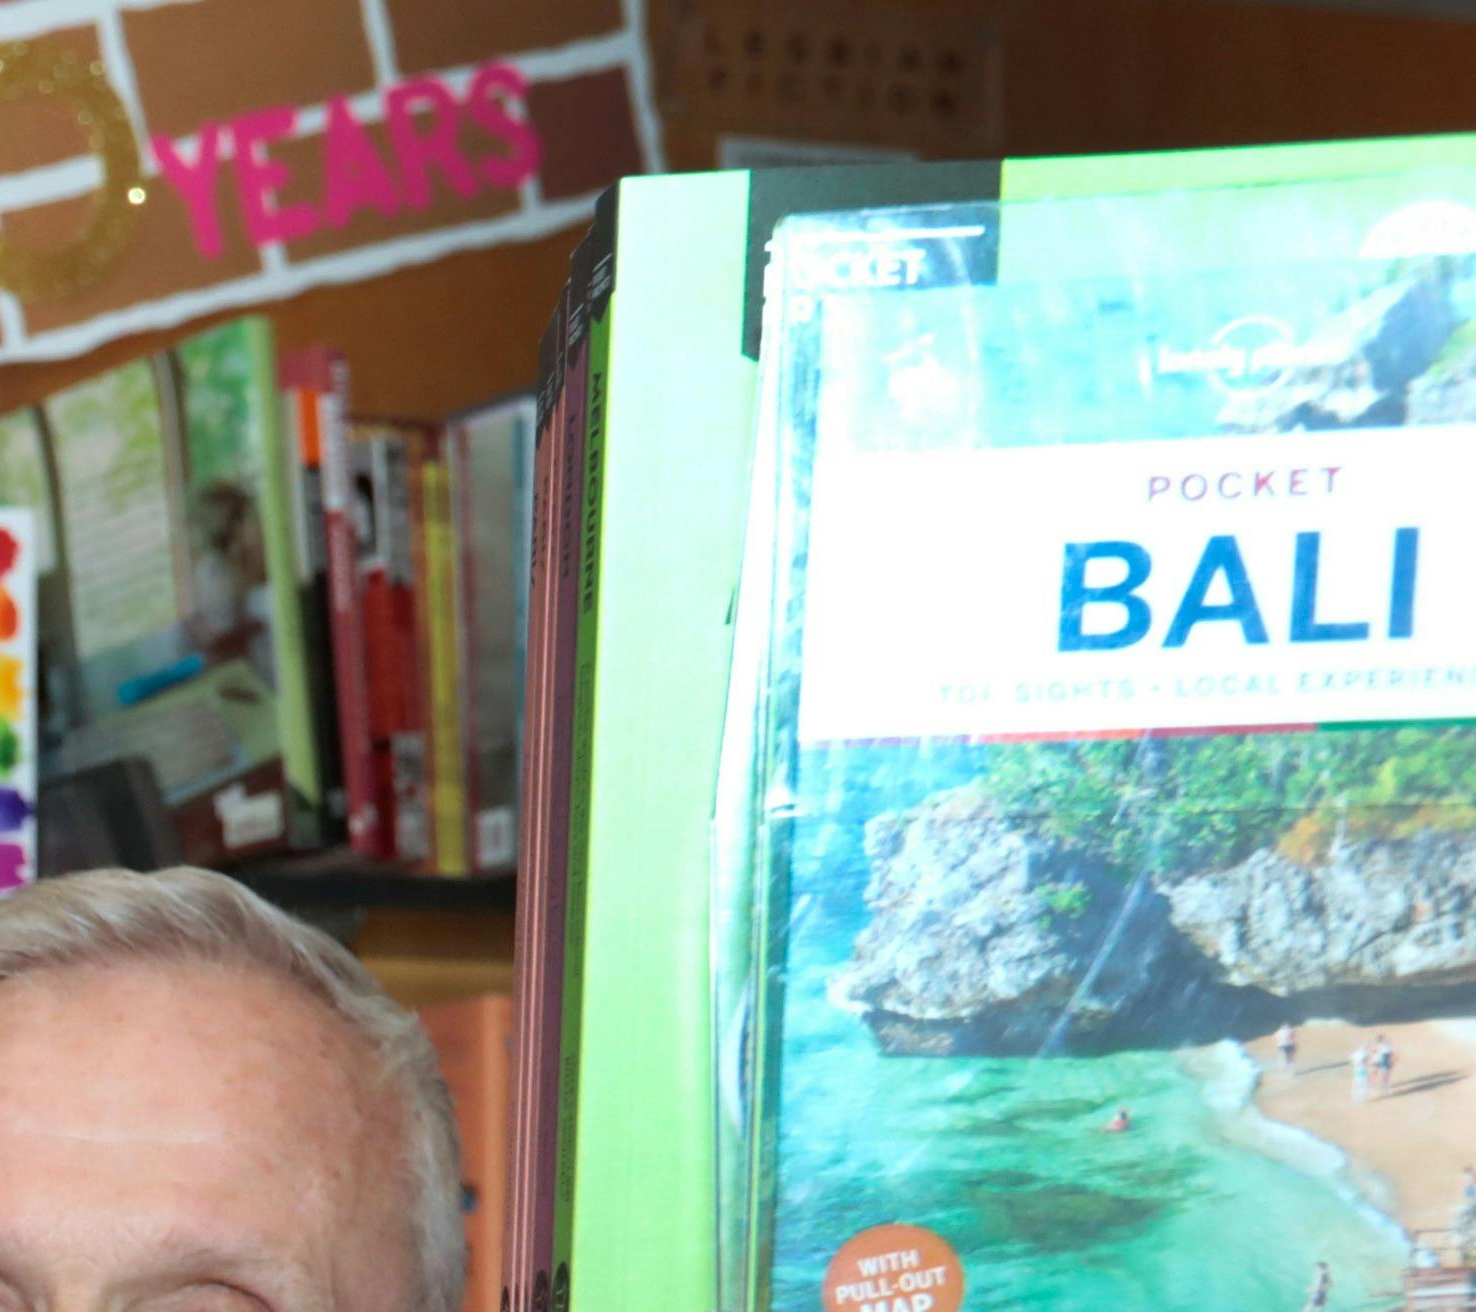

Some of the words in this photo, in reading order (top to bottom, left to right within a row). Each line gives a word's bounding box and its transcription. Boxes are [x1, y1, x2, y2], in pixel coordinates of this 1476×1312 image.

[145, 58, 547, 260] YEARS
[583, 372, 603, 613] MELBOURNE
[1147, 465, 1345, 501] POCKET
[1056, 526, 1421, 654] BALI
[1016, 676, 1137, 703] SIGHTS
[1174, 670, 1280, 700] LOCAL
[856, 1247, 921, 1277] WITH
[834, 1265, 948, 1306] PULL-OUT
